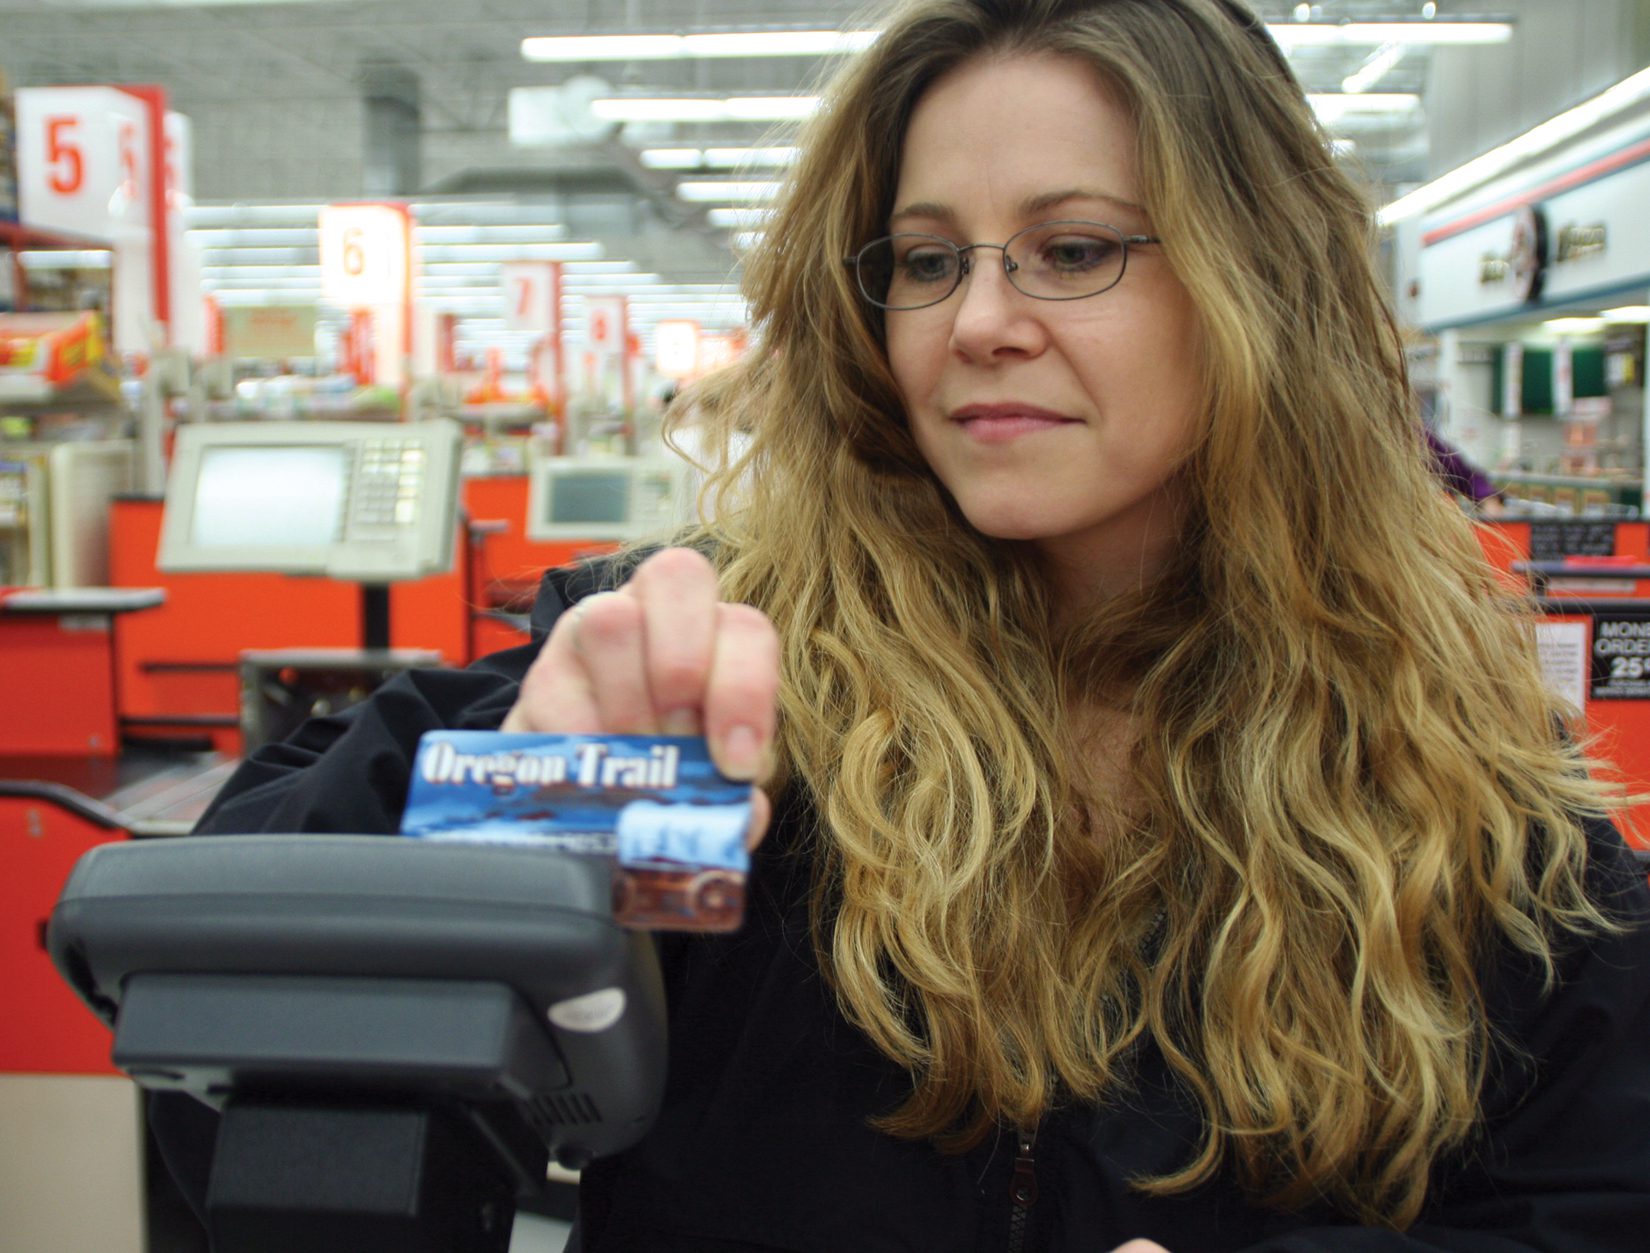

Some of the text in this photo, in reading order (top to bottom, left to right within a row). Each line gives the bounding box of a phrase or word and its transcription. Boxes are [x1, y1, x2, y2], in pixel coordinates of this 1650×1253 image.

[46, 117, 84, 194] 5
[342, 226, 366, 277] 6
[1595, 639, 1650, 655] ORDE
[422, 743, 679, 795] Oregon Trail
